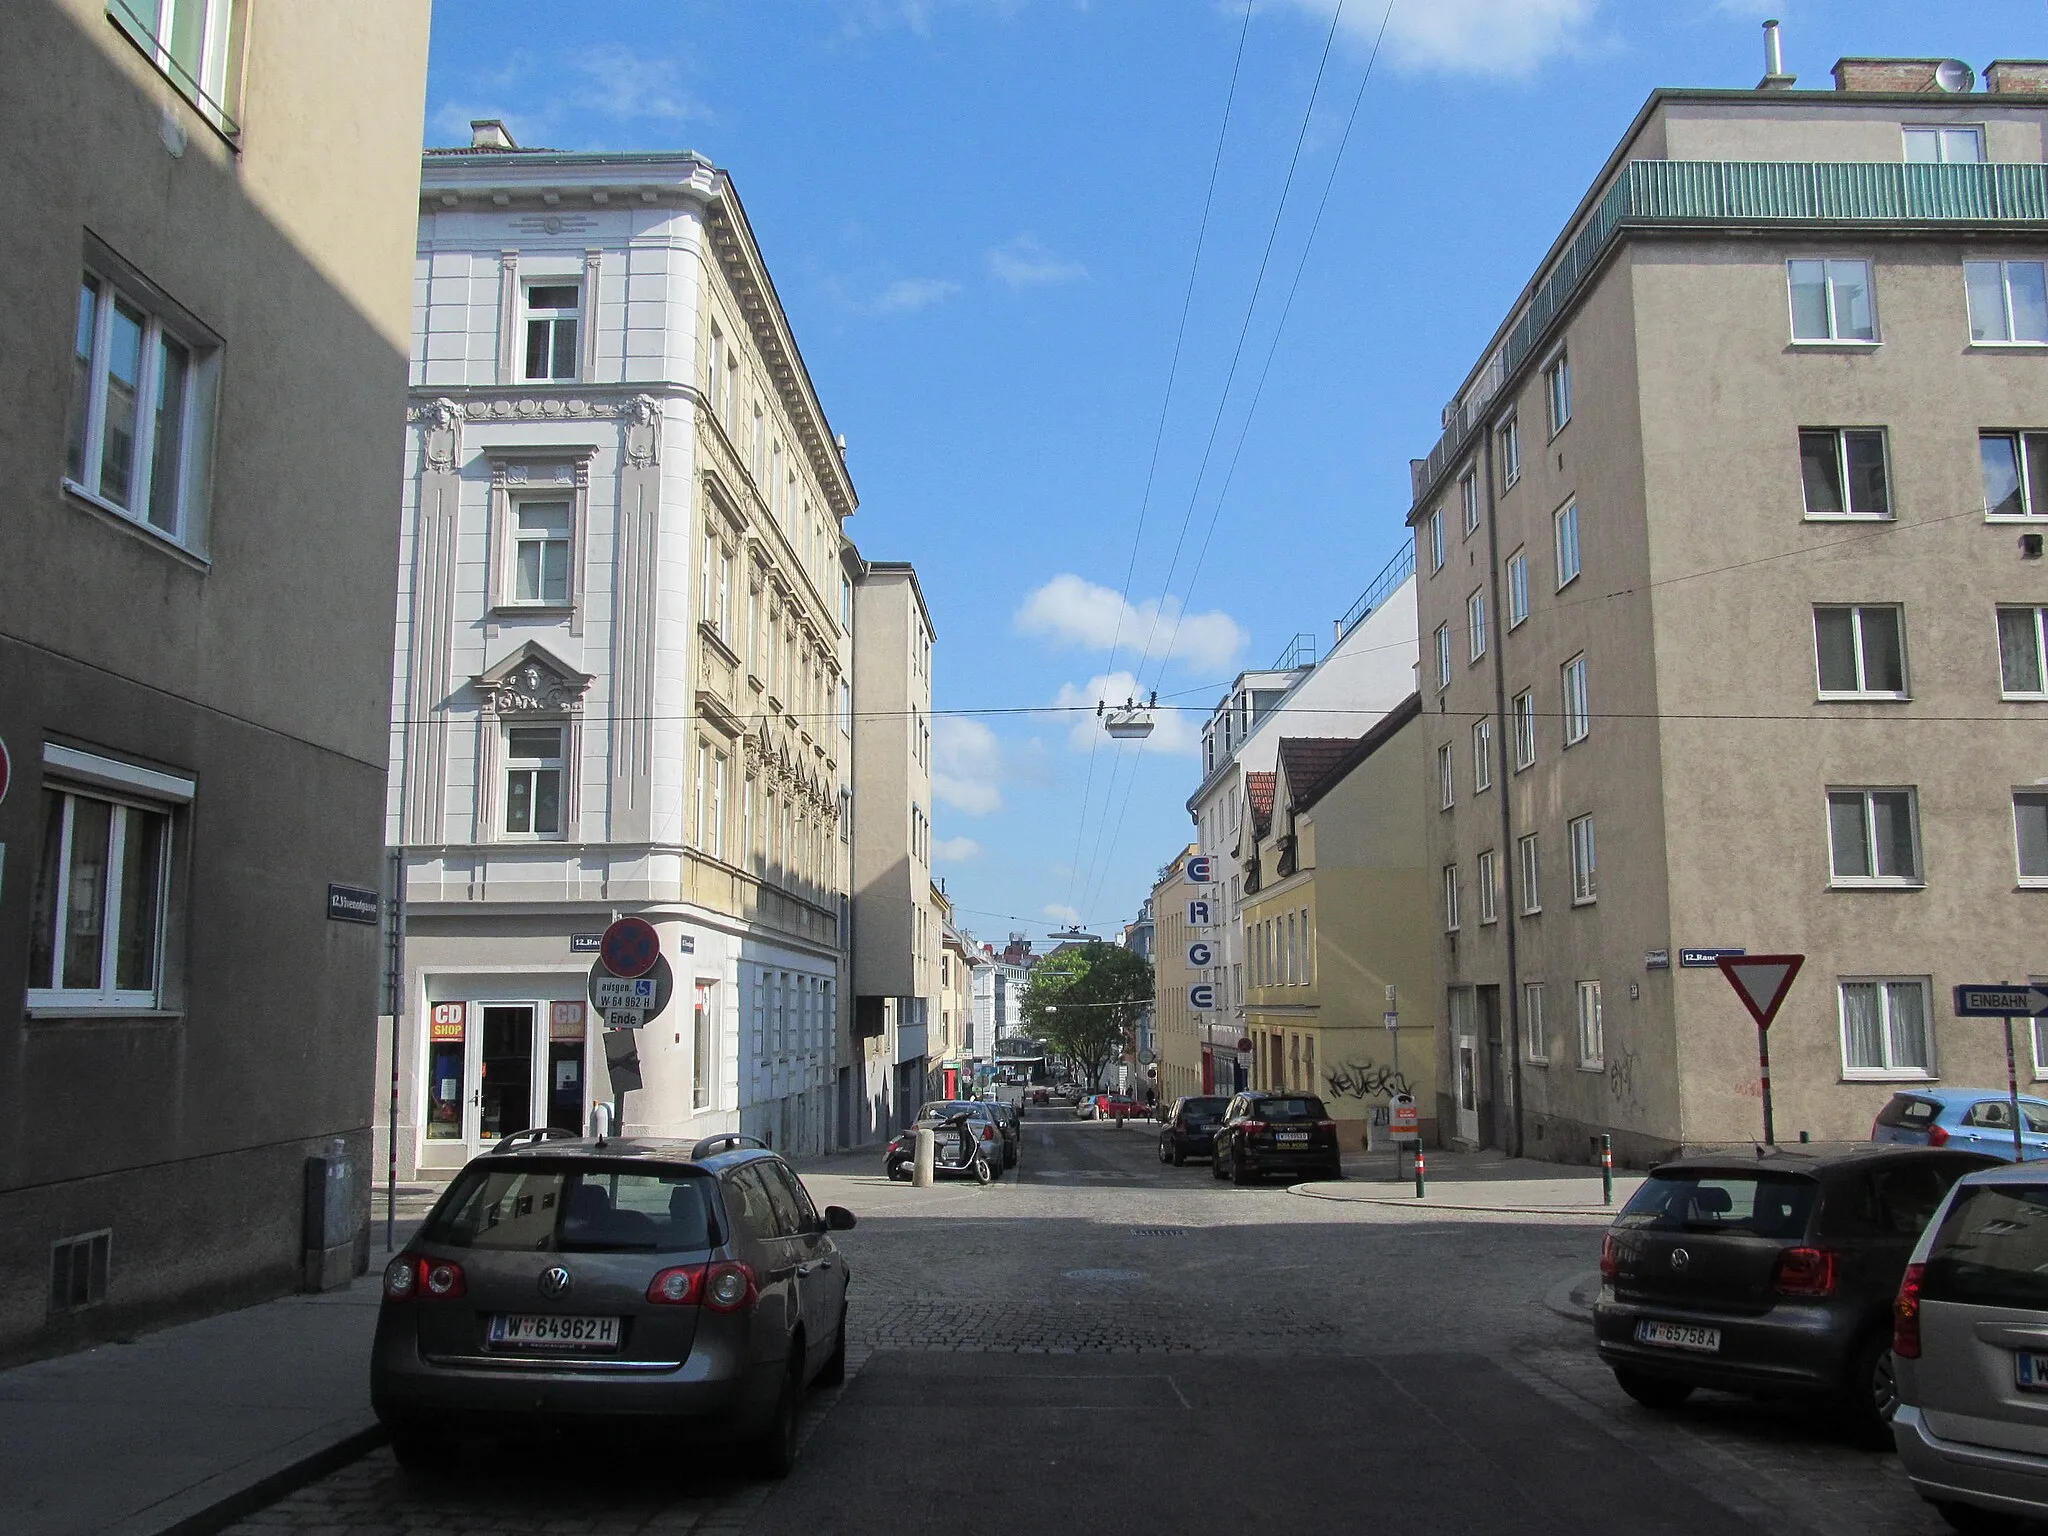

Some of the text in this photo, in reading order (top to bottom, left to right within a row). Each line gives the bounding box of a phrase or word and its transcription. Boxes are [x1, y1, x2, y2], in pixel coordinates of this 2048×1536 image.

[601, 982, 632, 994] ausgen.
[612, 996, 622, 1007] 64
[625, 996, 641, 1007] 962
[644, 997, 650, 1008] H
[1970, 994, 2028, 1008] EINBAHN
[435, 1004, 463, 1024] CD
[553, 1004, 582, 1024] CD
[610, 1011, 637, 1024] Ende
[434, 1024, 462, 1036] SHOP
[553, 1024, 581, 1035] SHOP
